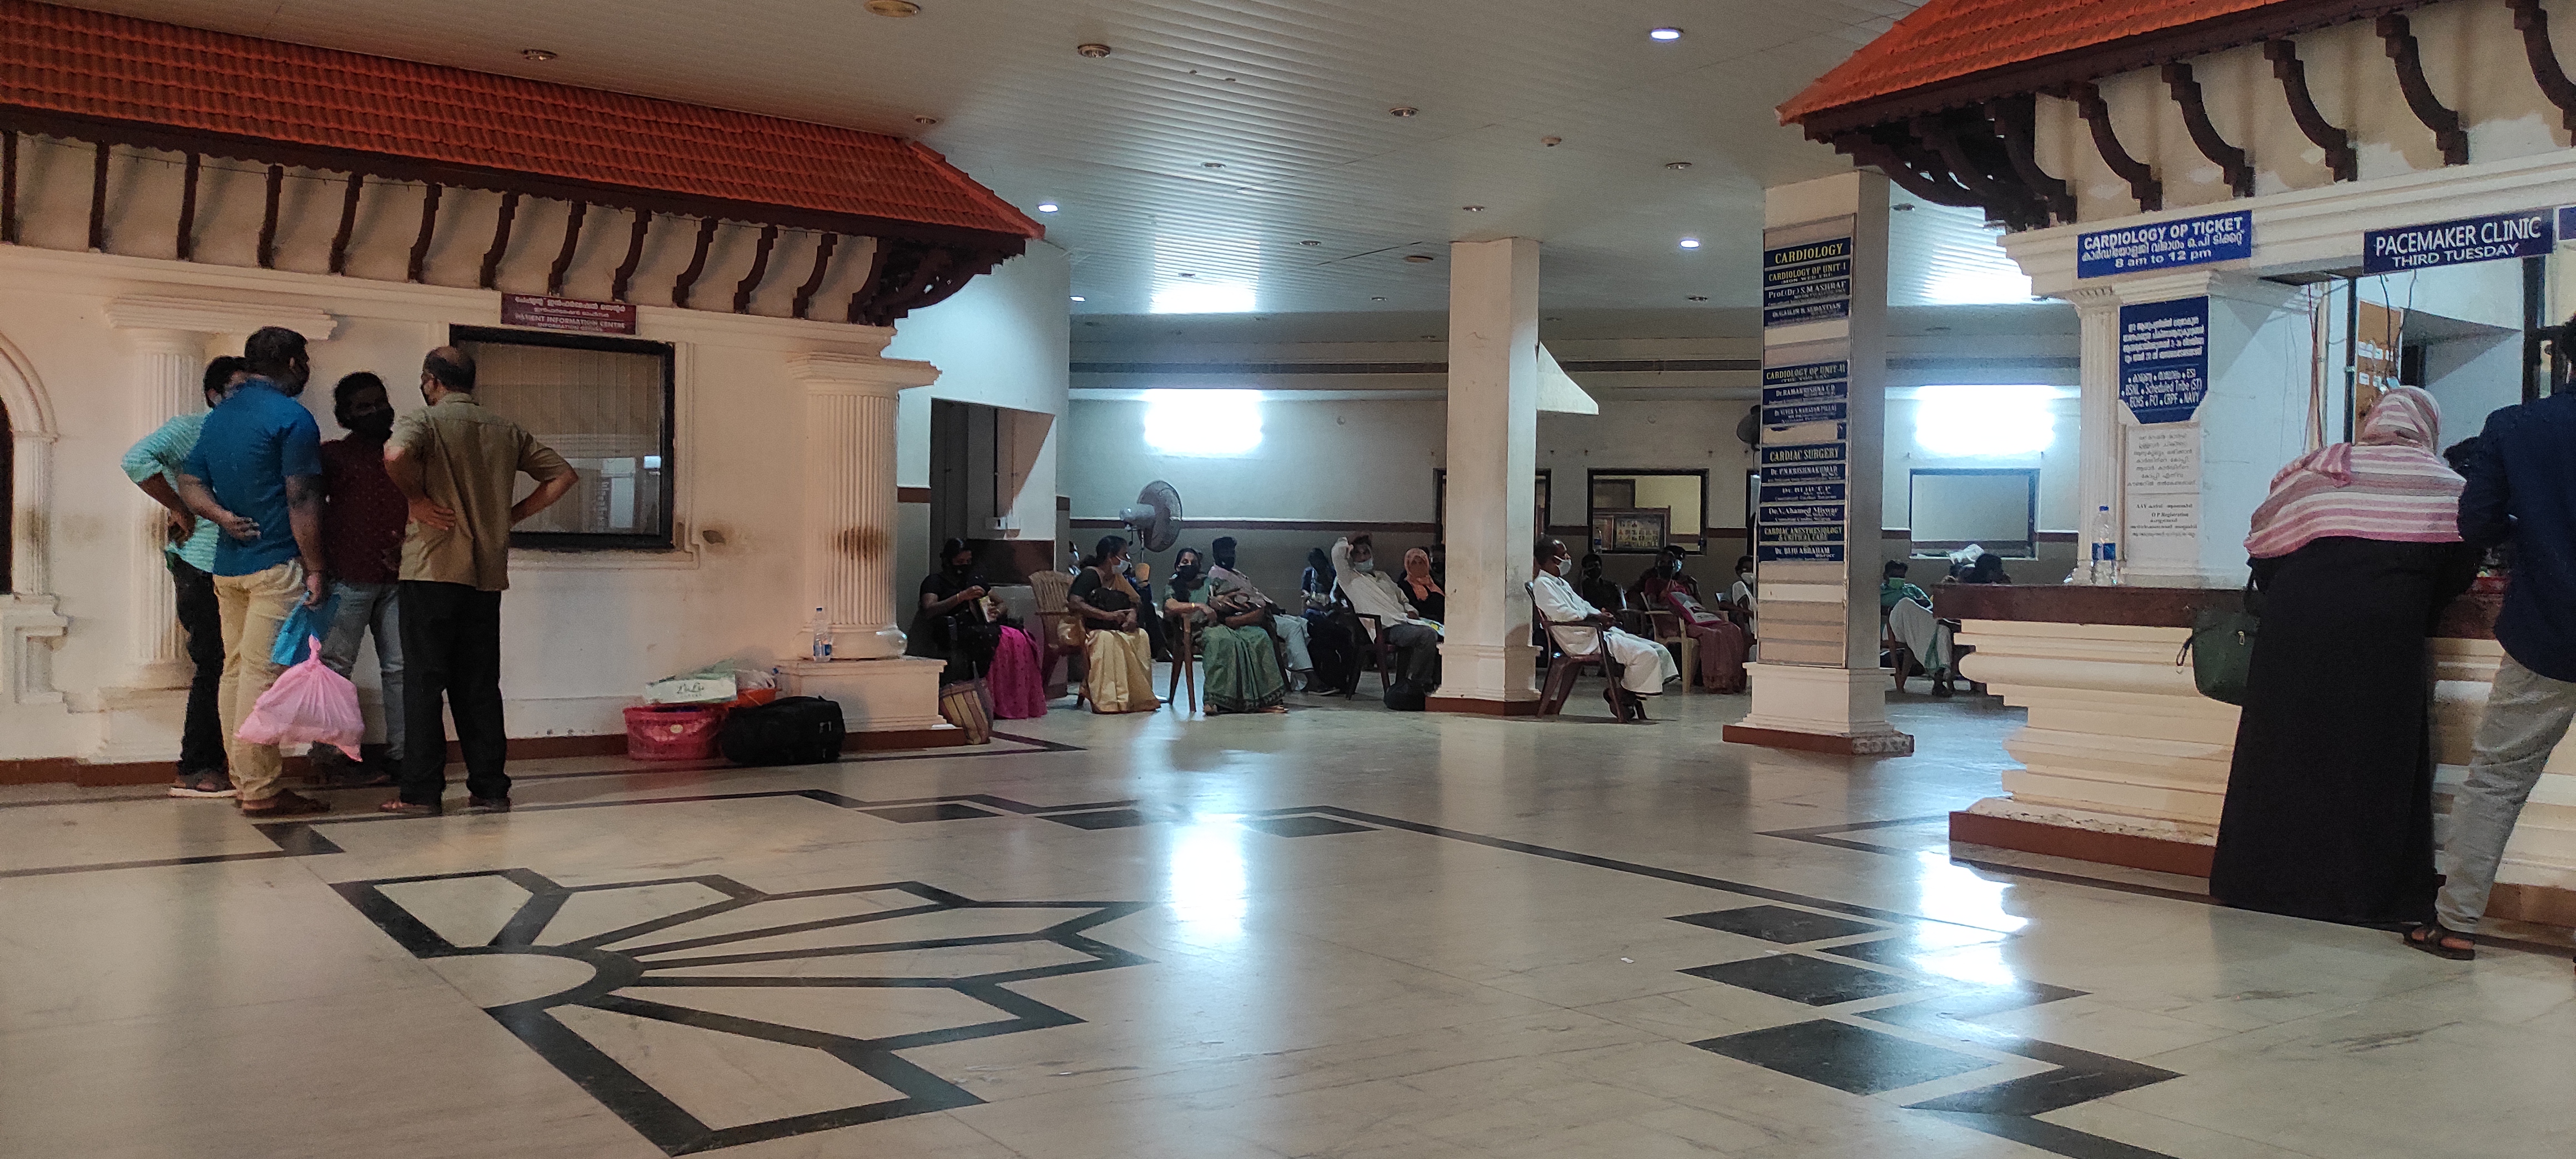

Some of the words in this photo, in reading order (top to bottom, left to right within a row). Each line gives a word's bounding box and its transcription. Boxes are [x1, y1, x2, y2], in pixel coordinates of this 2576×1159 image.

[2084, 226, 2166, 250] CARDIOLOGY
[2170, 224, 2188, 238] OP
[2192, 216, 2243, 235] TICKET
[2375, 224, 2476, 257] PACEMAKER
[2481, 216, 2542, 244] CLINIC
[1775, 243, 1843, 264] CARDIOLOGY
[2115, 258, 2124, 268] 8
[2127, 257, 2147, 266] am
[2150, 255, 2165, 264] to
[2168, 250, 2187, 262] 12
[2190, 249, 2212, 261] pm
[2392, 252, 2439, 268] THIRD
[2444, 243, 2519, 262] TUESDAY
[1769, 268, 1810, 281] CARDIOLOGY
[1812, 266, 1821, 275] OP
[1767, 369, 1807, 380] CARDIOLOGY
[1769, 448, 1802, 462] CARDIAC
[1804, 447, 1839, 460] SURGERY
